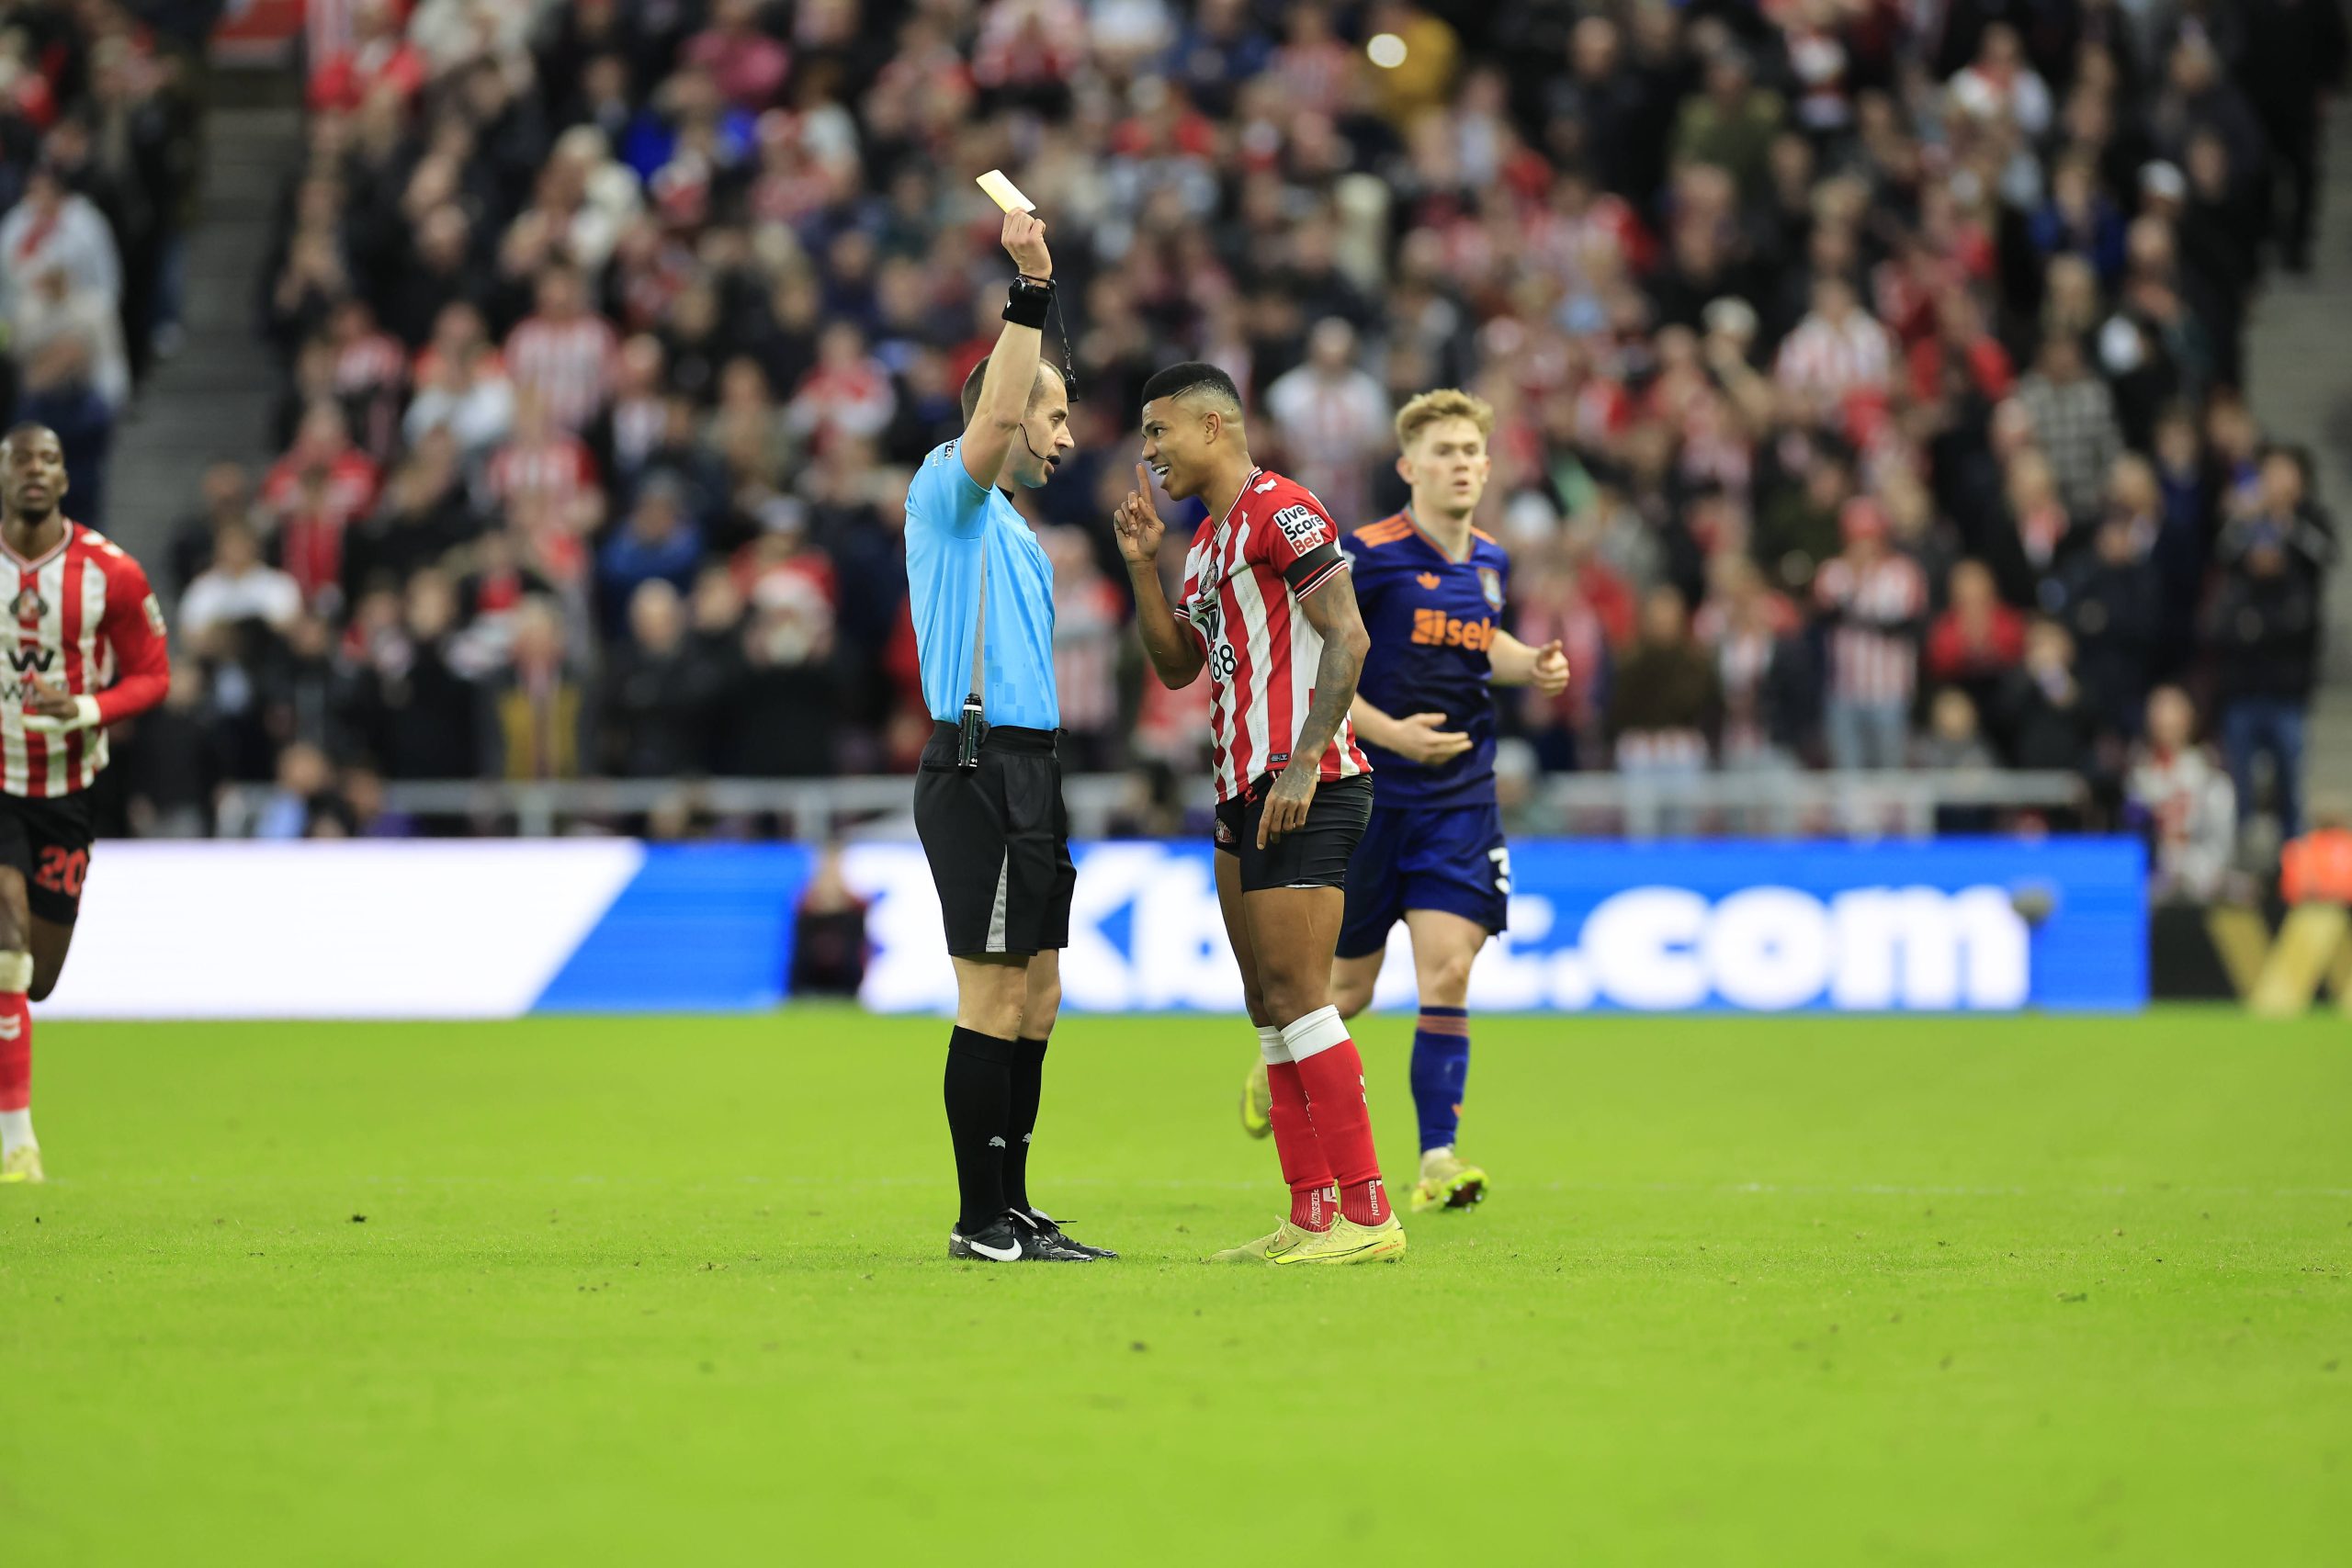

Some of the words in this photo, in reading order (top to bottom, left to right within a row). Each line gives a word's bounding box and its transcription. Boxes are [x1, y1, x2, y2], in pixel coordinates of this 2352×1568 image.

[1275, 506, 1307, 527] Live
[1284, 516, 1324, 541] Score
[1292, 531, 1322, 555] Bet
[1445, 616, 1498, 651] sel
[7, 649, 55, 672] W
[1210, 644, 1237, 681] 88
[36, 846, 87, 897] 20
